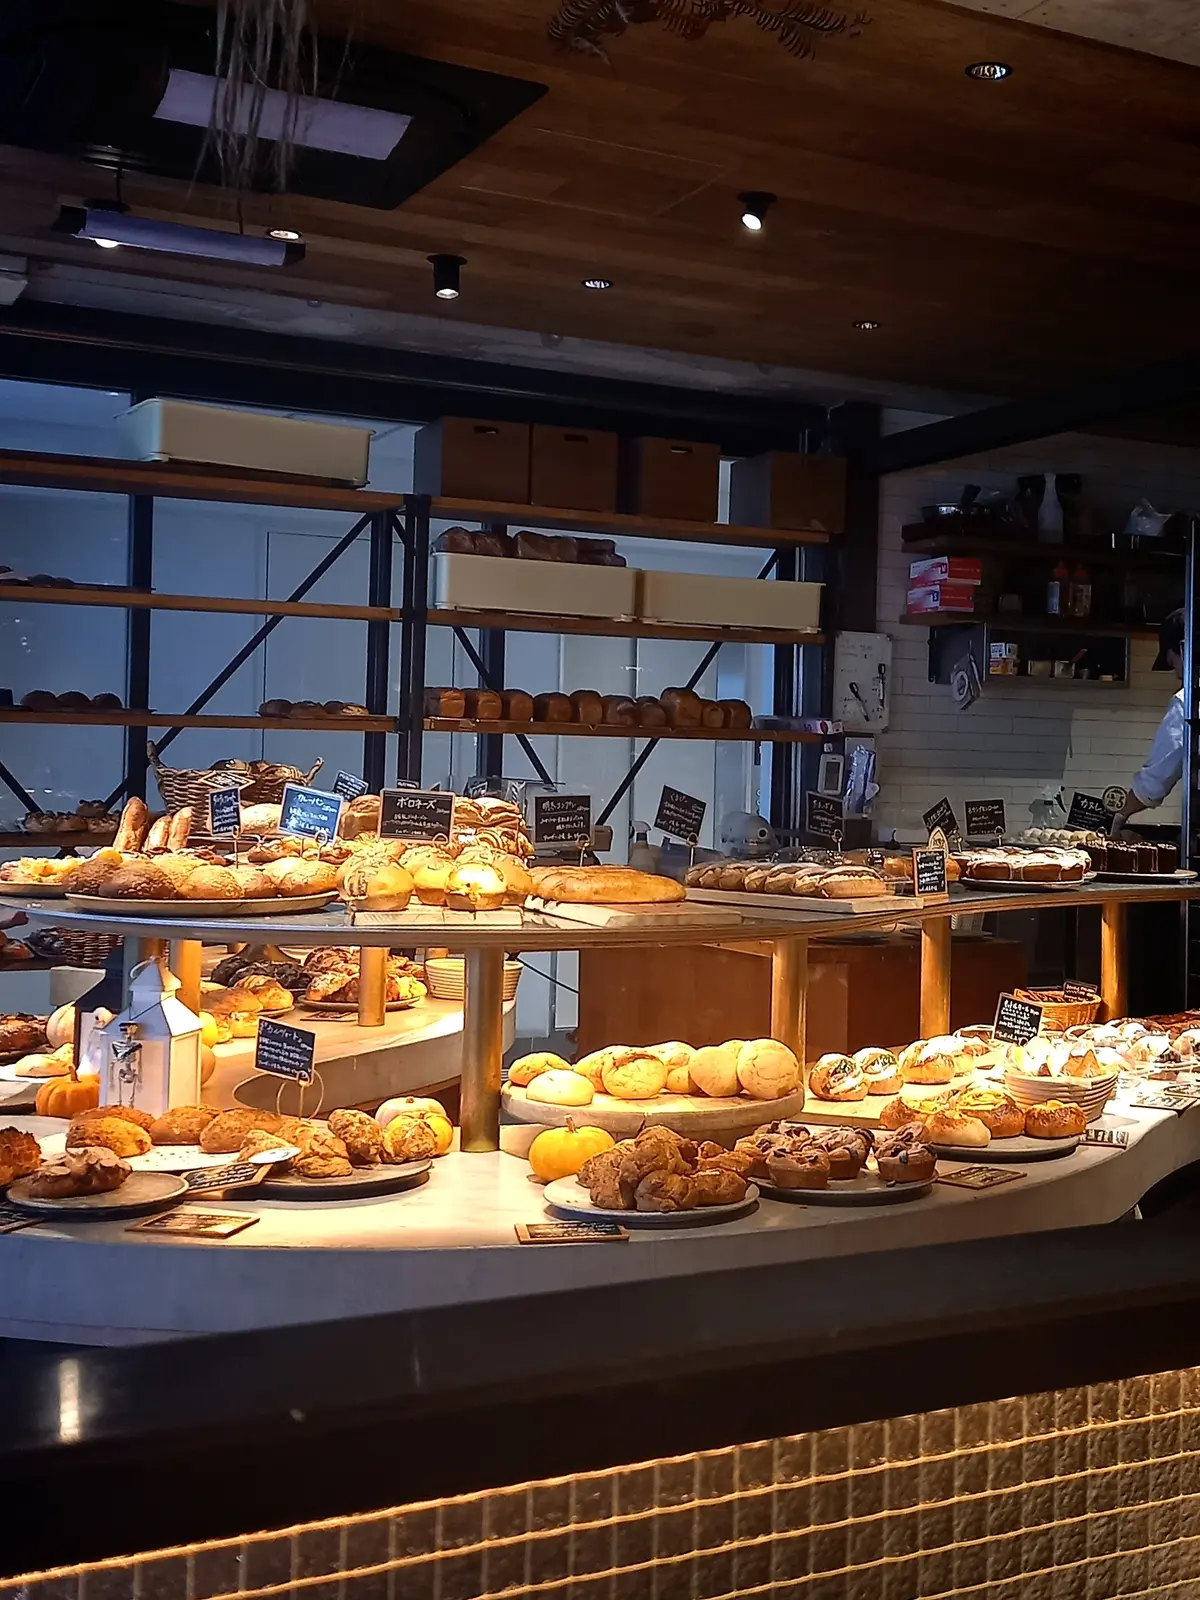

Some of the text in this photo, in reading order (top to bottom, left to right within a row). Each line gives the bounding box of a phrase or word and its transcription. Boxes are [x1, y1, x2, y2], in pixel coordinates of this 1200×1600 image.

[396, 797, 437, 810] ボロネーズ
[1080, 798, 1102, 811] カヌレ
